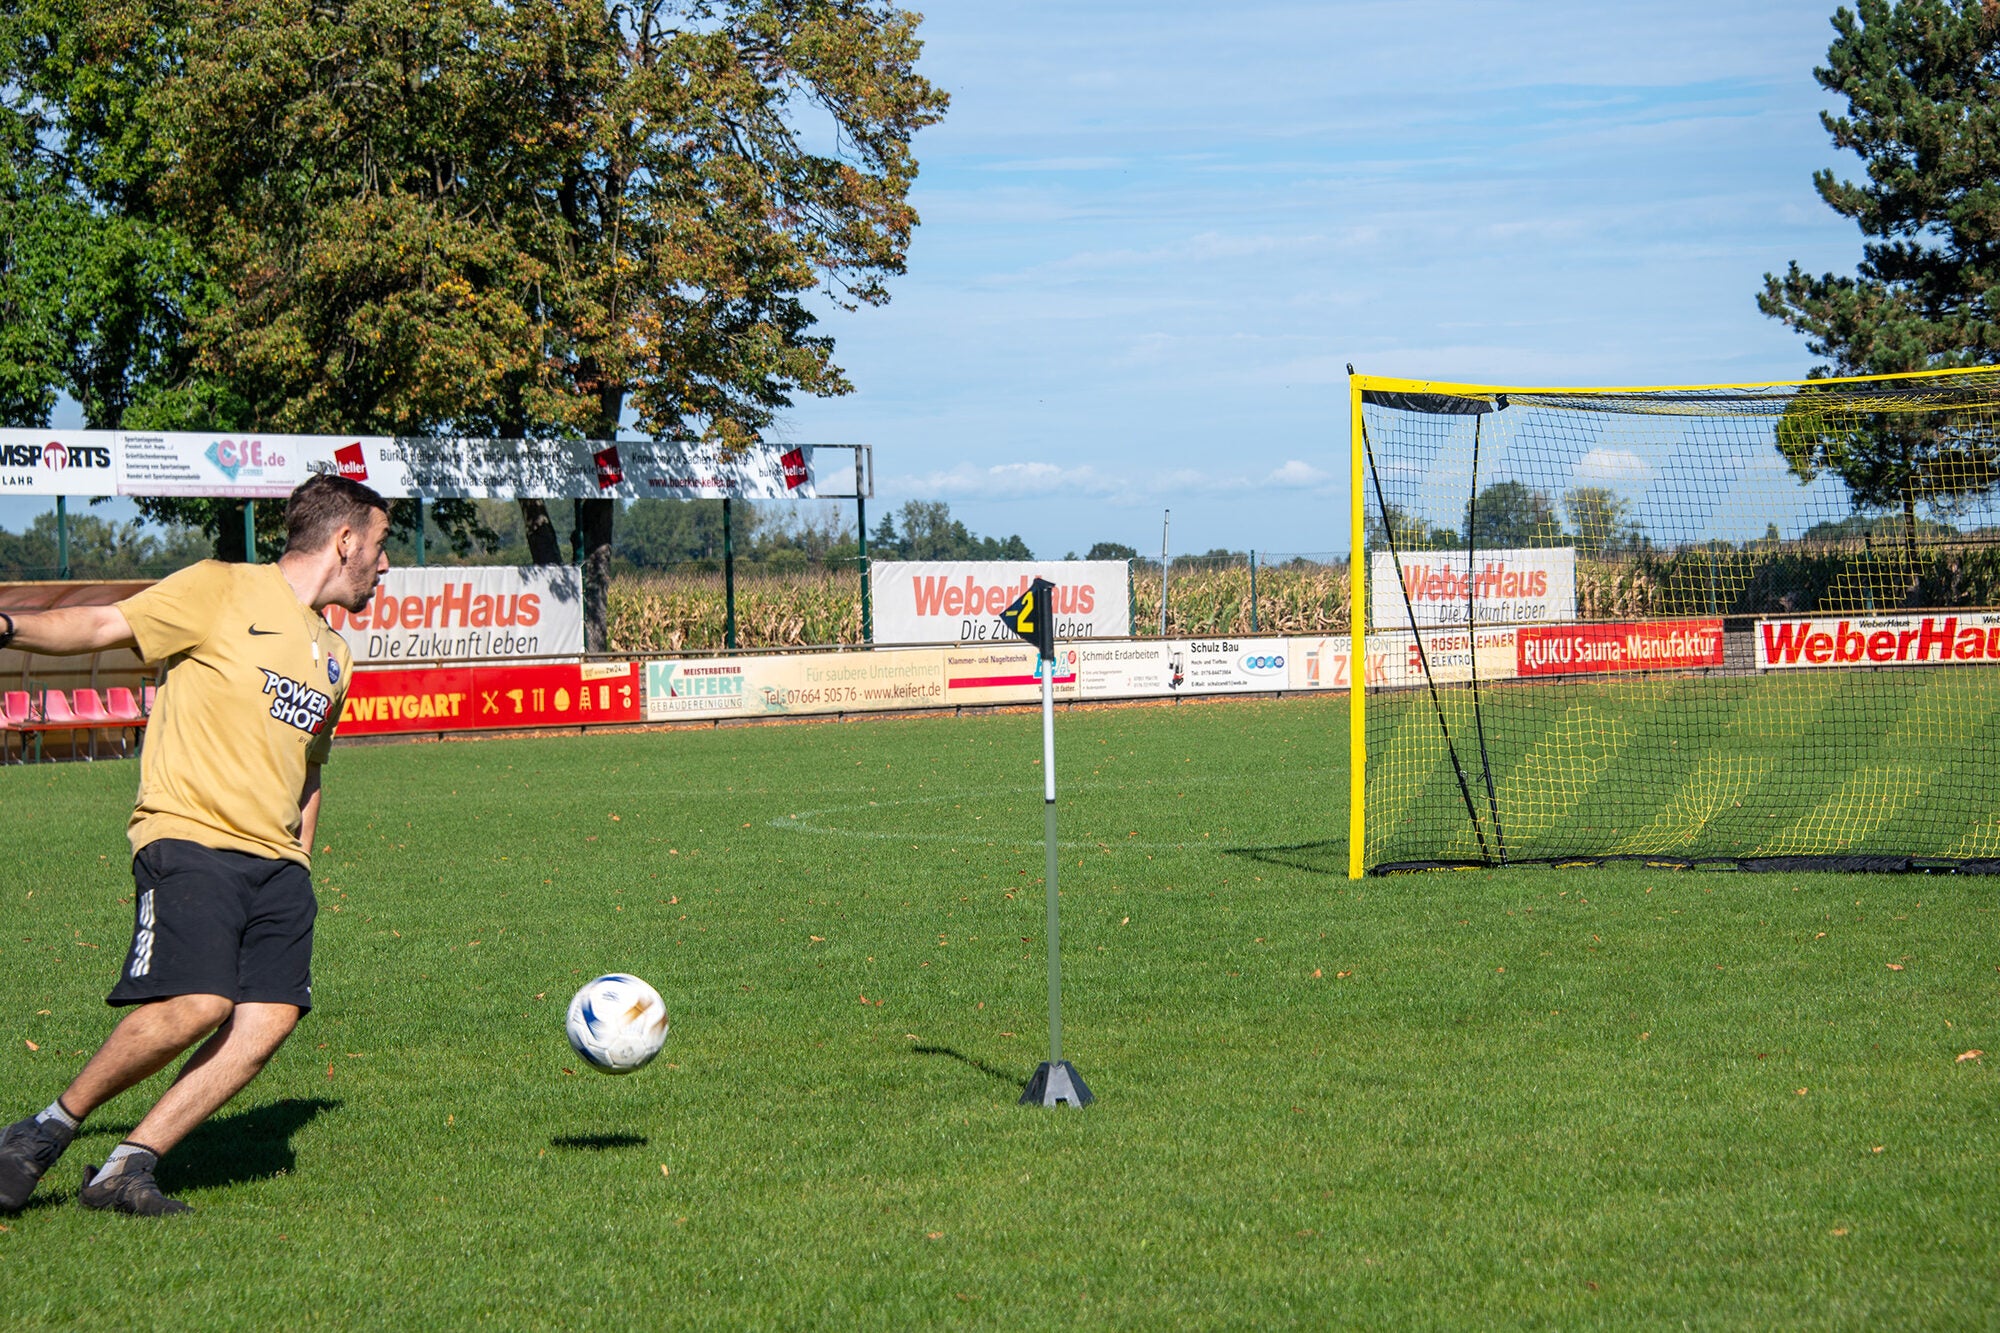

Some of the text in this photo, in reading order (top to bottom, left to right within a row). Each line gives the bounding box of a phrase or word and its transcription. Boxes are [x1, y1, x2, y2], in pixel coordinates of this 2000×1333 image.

[338, 461, 366, 474] keller
[784, 464, 806, 477] keller
[2, 476, 34, 486] LAHR
[1403, 563, 1548, 602] WeberHaus
[1440, 600, 1546, 623] Die Zukunft leben
[960, 619, 987, 641] Die
[1053, 617, 1093, 638] leben
[1859, 619, 1911, 629] WeberHaus
[368, 631, 539, 659] Die Zukunft leben
[1190, 641, 1239, 653] Schulz Bau
[1431, 633, 1515, 651] ROSENEHNER
[1524, 631, 1717, 669] RUKU Sauna-Manufaktur
[948, 653, 1028, 665] Klammer- und Nageltechnik
[1082, 649, 1160, 661] Schmidt Erdarbeiten
[1431, 654, 1471, 668] ELEKTRO
[683, 666, 742, 676] MEISTERBETRIEB
[806, 662, 941, 682] Für saubere Unternehmen
[1332, 654, 1389, 686] ZNK
[257, 666, 331, 716] POWER
[787, 687, 821, 705] 07664
[864, 682, 941, 701] www.keifert.de
[269, 697, 325, 735] SHOT
